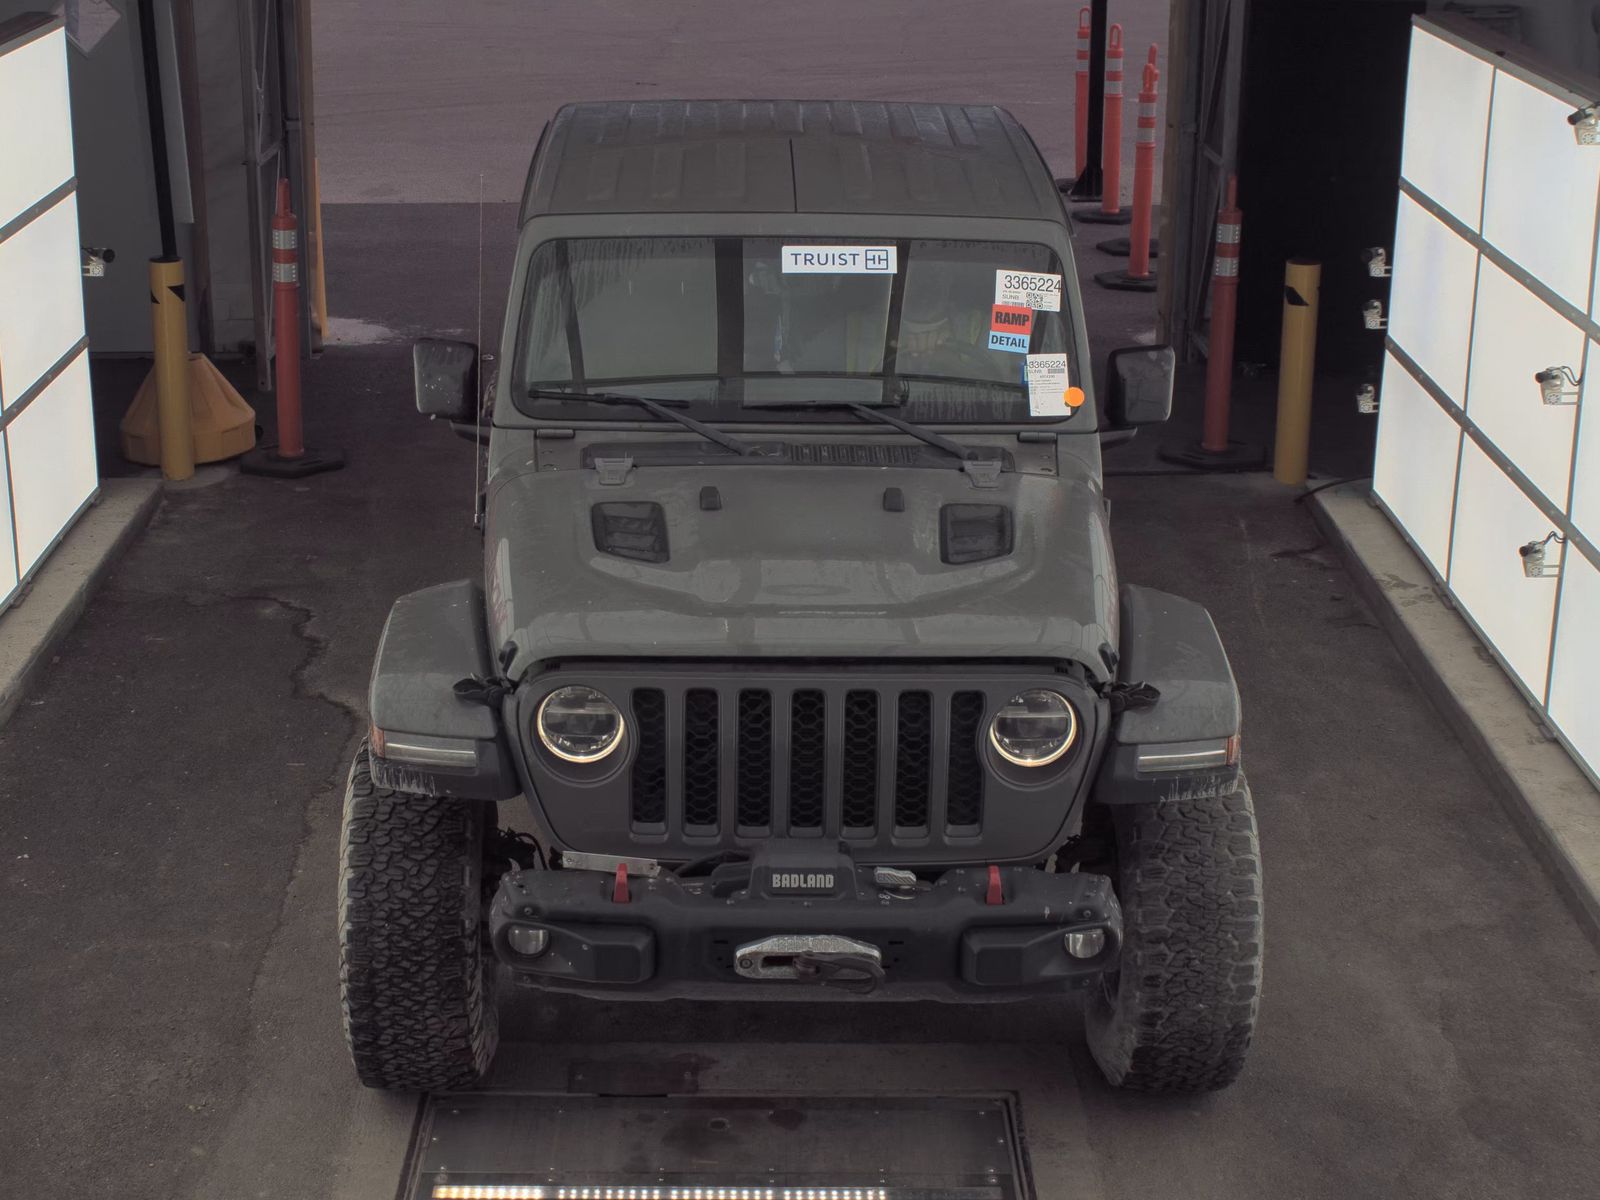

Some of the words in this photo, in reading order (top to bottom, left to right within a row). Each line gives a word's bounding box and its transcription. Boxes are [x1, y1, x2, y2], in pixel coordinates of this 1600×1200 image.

[790, 253, 860, 266] TRUIST
[1004, 274, 1062, 293] 3365224
[994, 311, 1030, 326] RAMP
[991, 335, 1027, 348] DETAIL
[1028, 360, 1066, 369] 3365224
[772, 873, 835, 888] BADLAND
